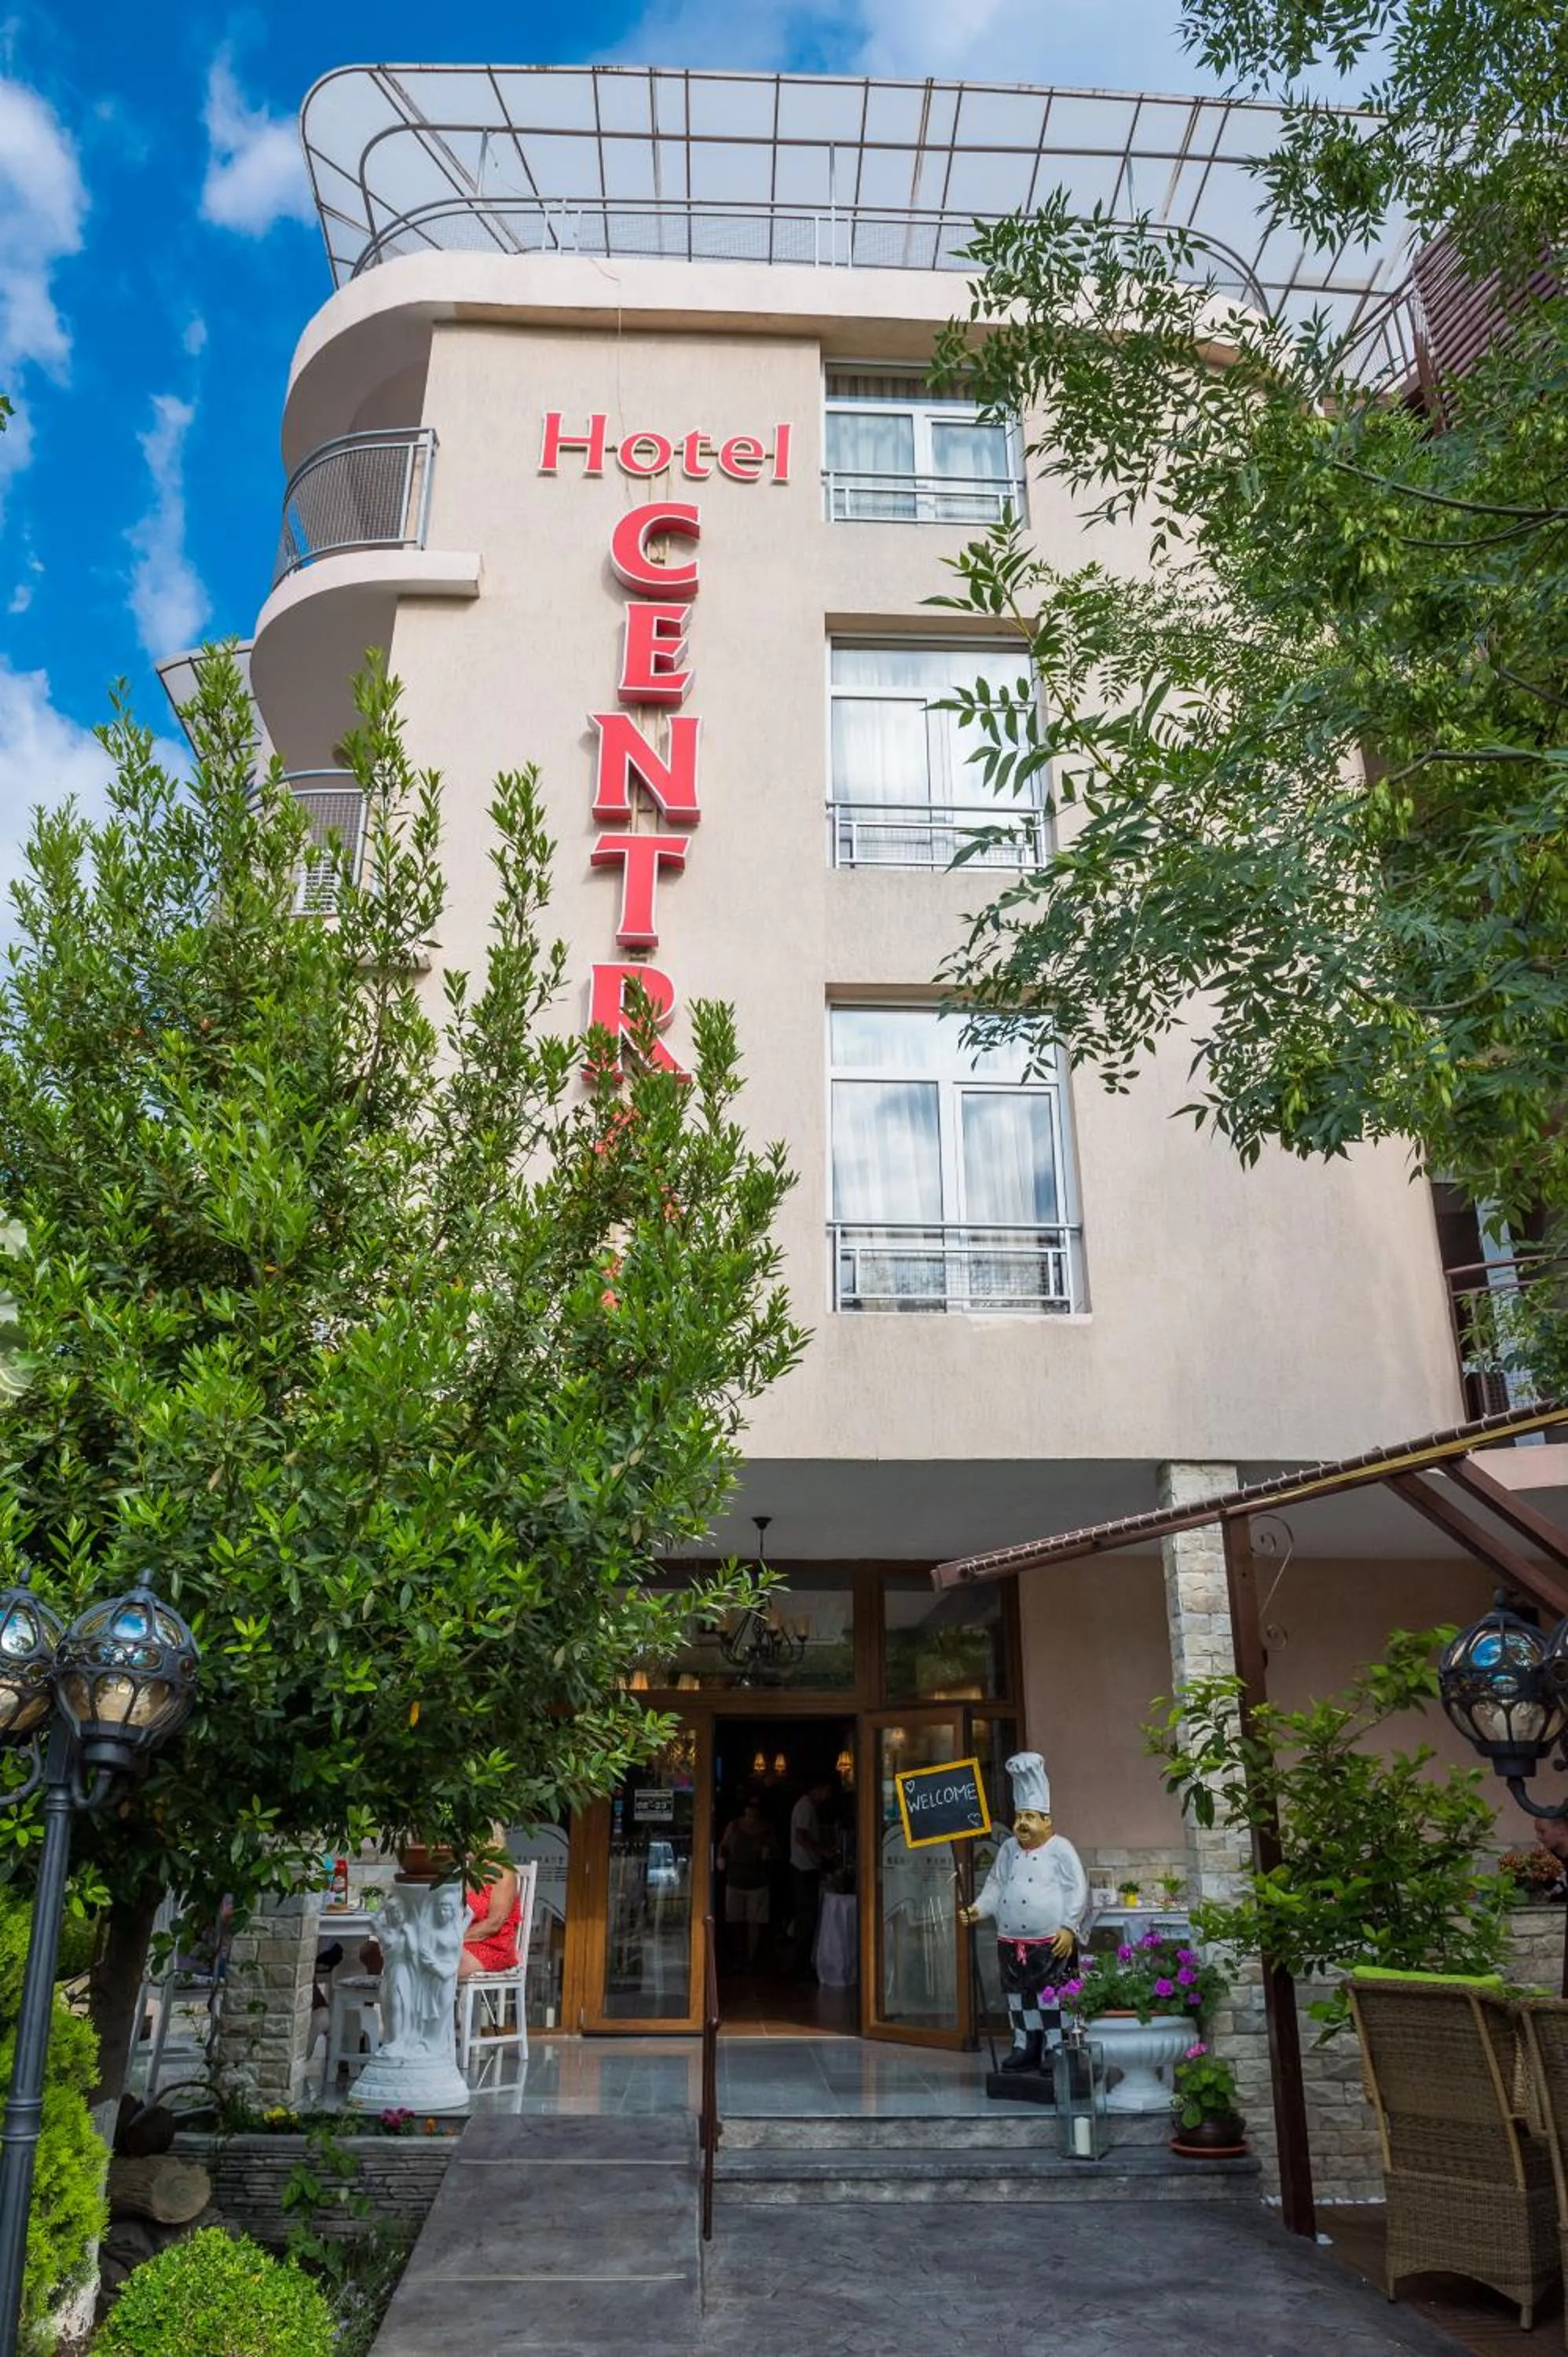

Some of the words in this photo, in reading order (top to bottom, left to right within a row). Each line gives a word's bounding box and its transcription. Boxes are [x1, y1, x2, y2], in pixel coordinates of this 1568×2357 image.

[539, 411, 793, 481] Hotel
[581, 501, 702, 1310] CENTR
[906, 1783, 978, 1814] WELCOME
